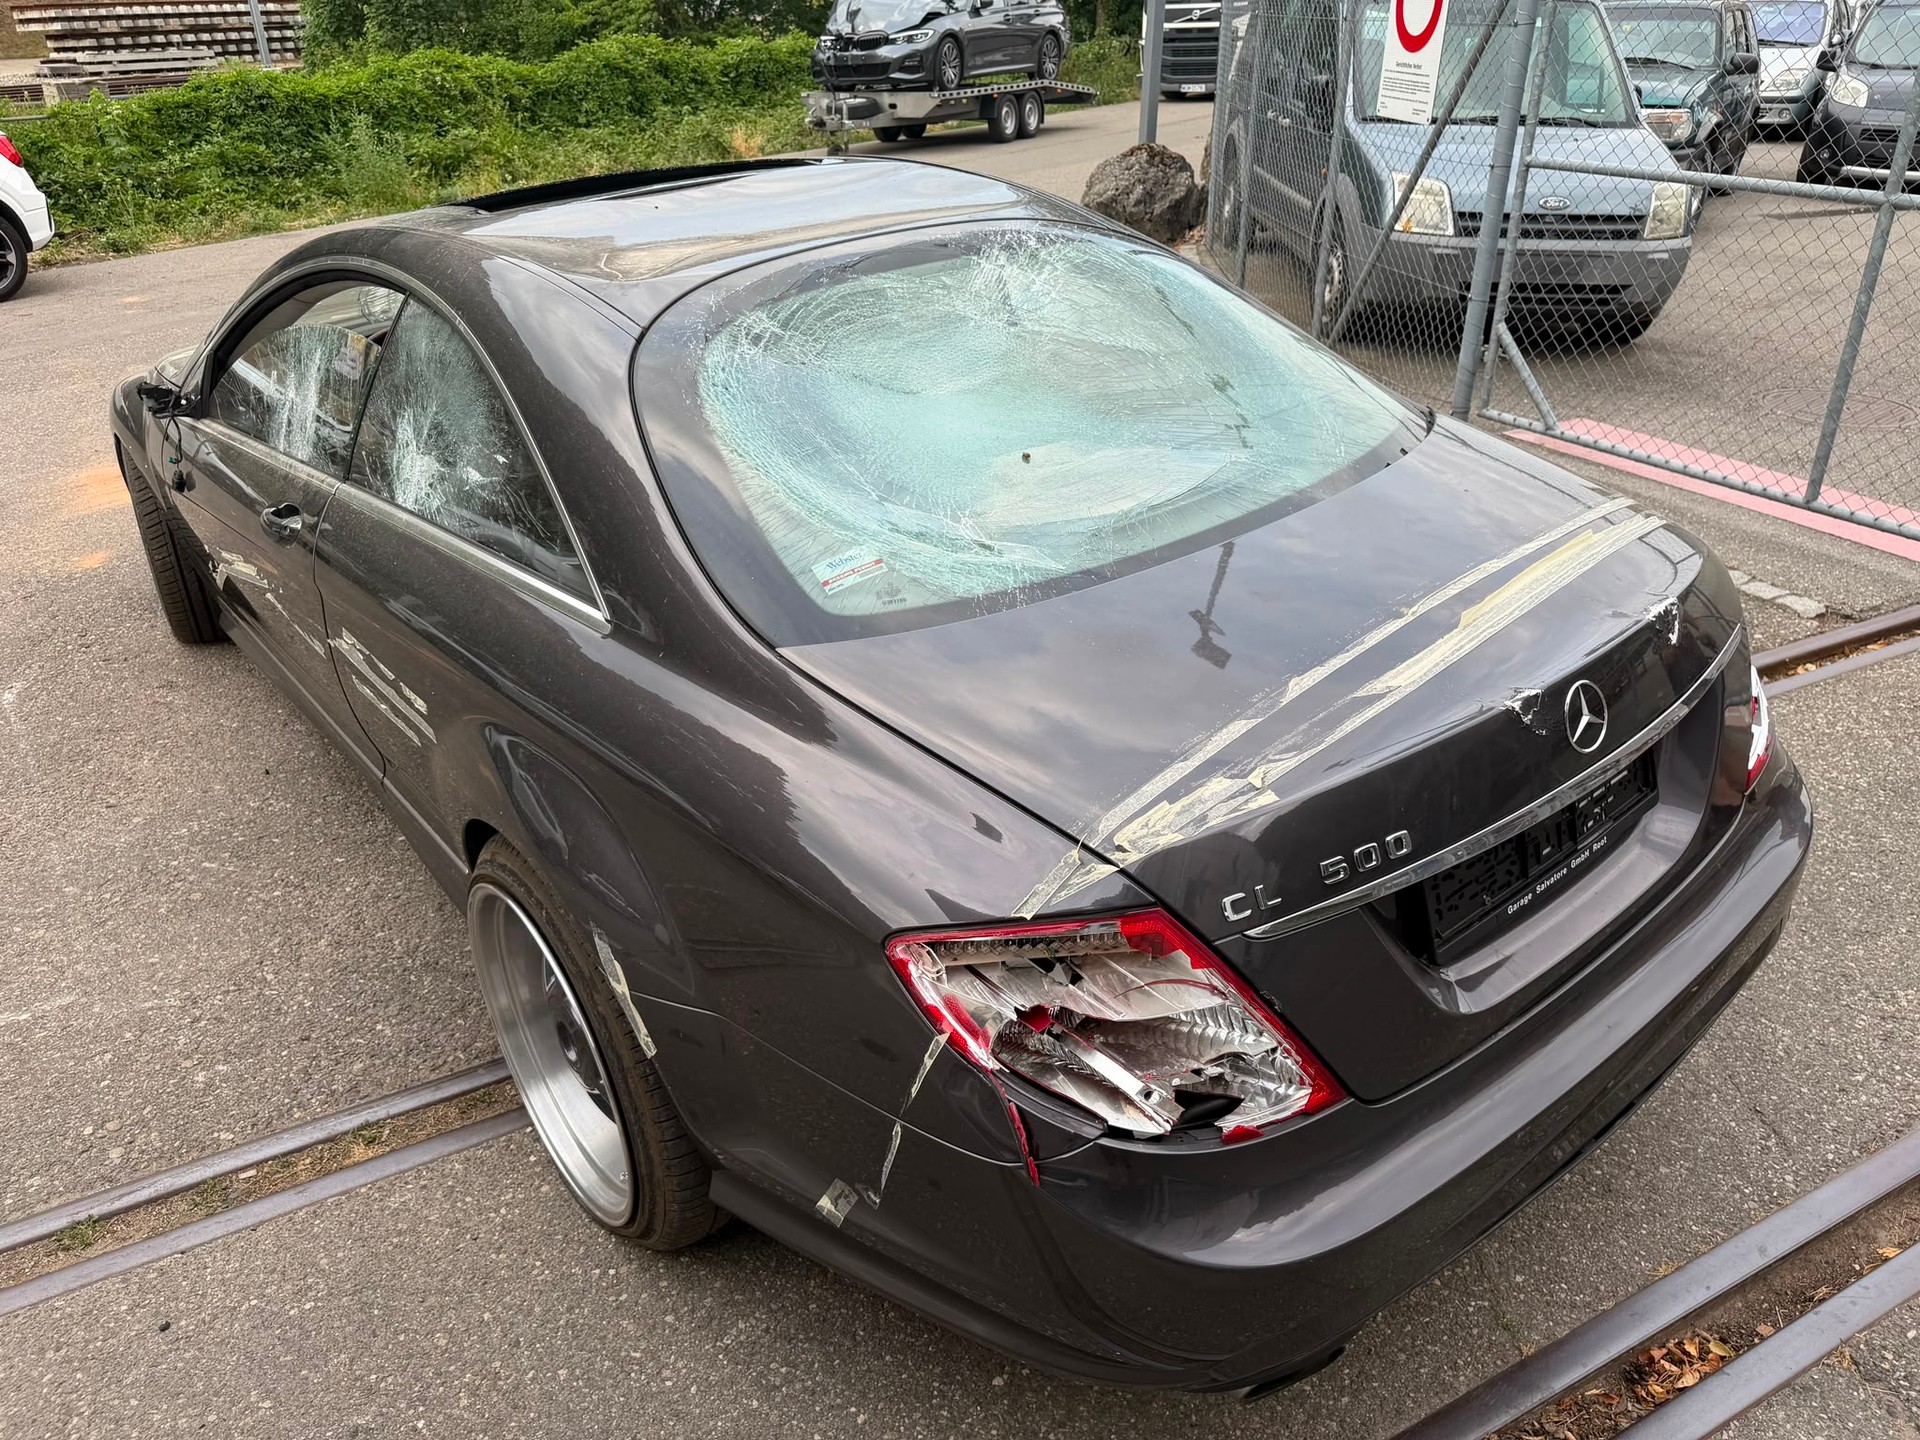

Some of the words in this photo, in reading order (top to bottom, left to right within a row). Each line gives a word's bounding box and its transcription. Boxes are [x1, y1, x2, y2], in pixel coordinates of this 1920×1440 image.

[1221, 885, 1282, 922] CL
[1319, 829, 1412, 885] 500
[1507, 892, 1533, 914] Garage
[1536, 868, 1568, 893] Salvatore
[1570, 849, 1590, 868] GmbH
